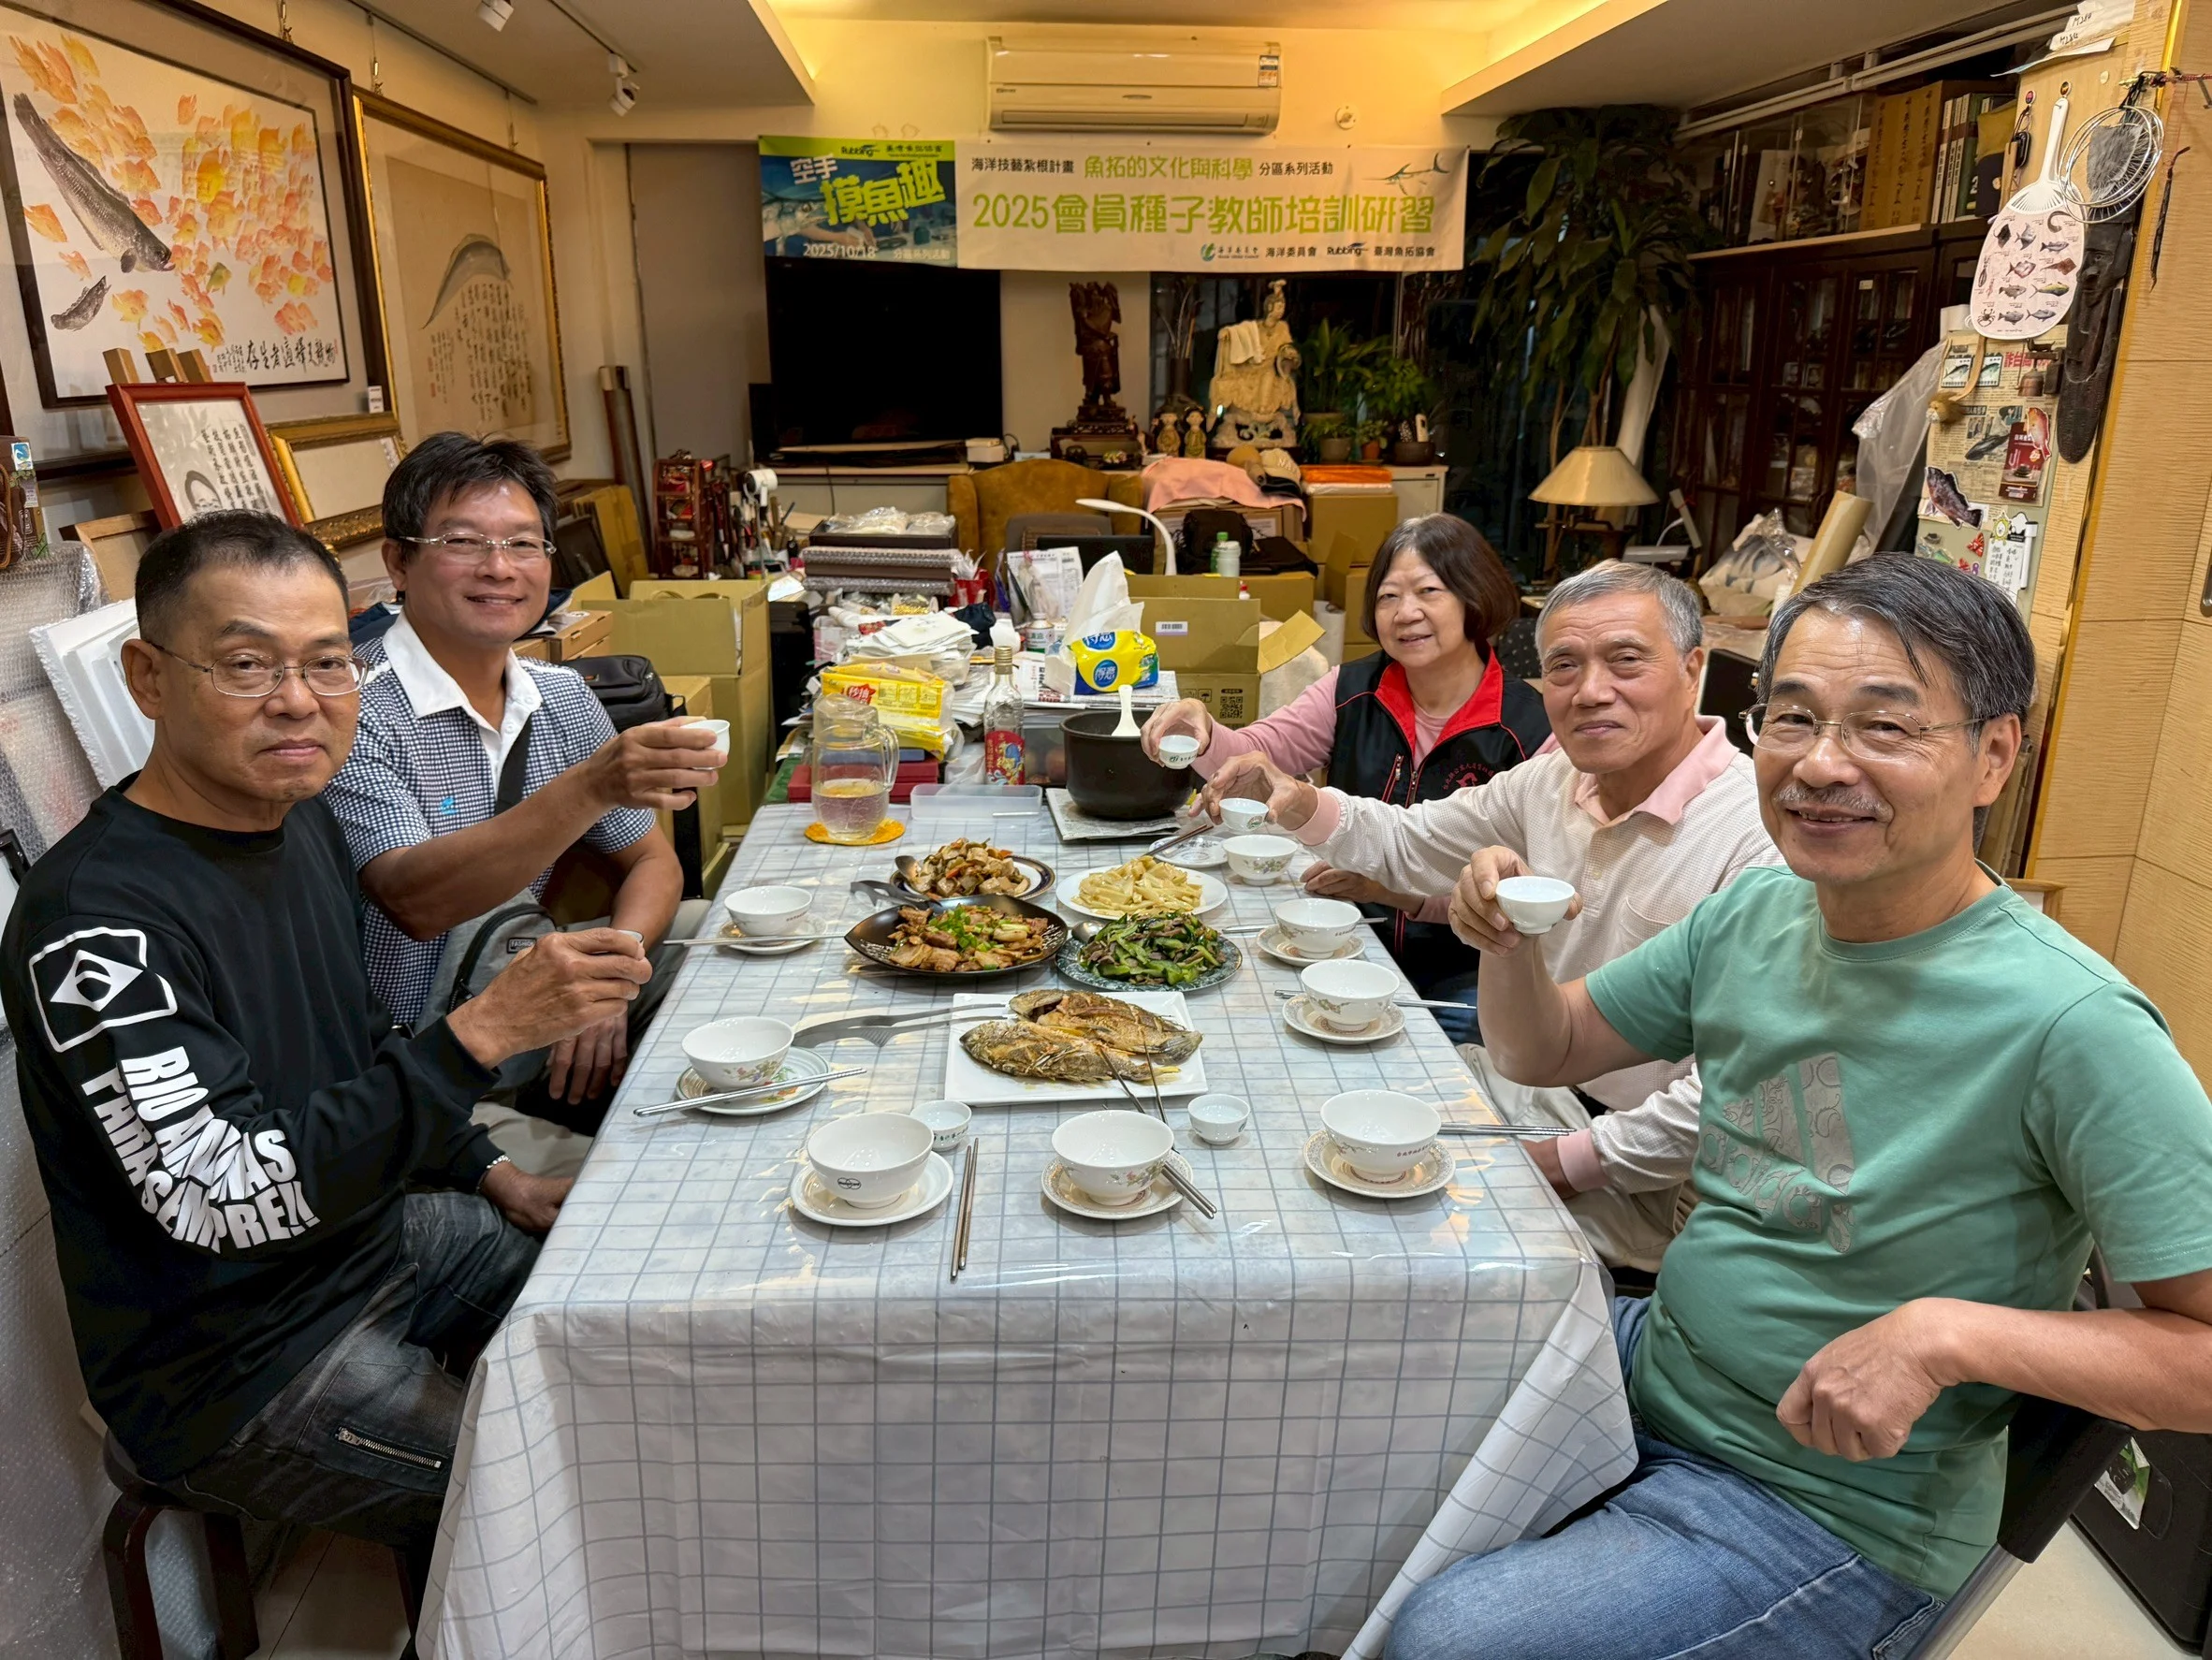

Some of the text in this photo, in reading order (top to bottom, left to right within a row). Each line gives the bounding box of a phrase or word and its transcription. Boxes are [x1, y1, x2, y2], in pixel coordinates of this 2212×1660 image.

[790, 153, 838, 184] 空手
[1084, 155, 1253, 181] 魚拓的文化與科學
[1259, 161, 1333, 176] 分區系列活動
[820, 157, 946, 227] 摸魚趣
[972, 193, 1435, 235] 2025會員種子教師培訓研習
[803, 243, 877, 259] 2025/10/18
[1265, 246, 1317, 258] 海洋委員會
[1327, 245, 1362, 257] Rubbing
[1374, 246, 1436, 258] 臺灣魚拓協會
[1095, 665, 1116, 681] 得意
[121, 1045, 210, 1122] RIO
